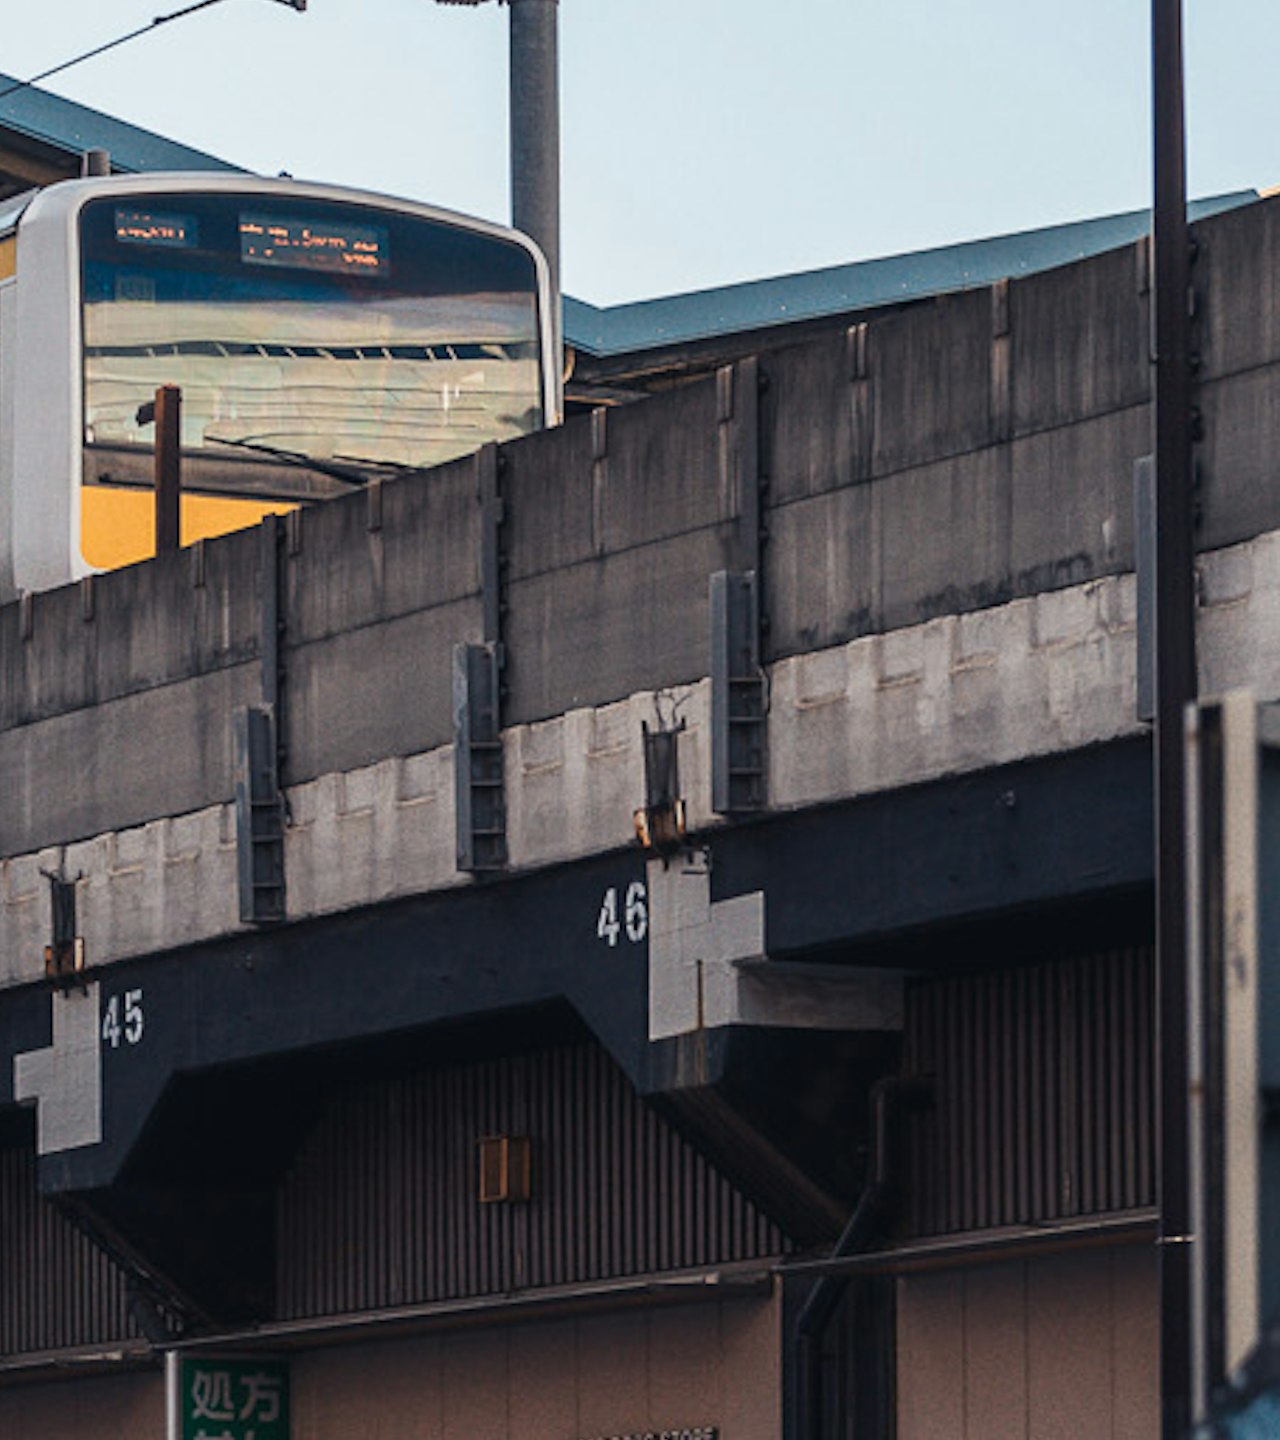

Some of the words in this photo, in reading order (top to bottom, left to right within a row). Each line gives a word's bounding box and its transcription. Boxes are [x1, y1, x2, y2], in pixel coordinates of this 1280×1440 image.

[597, 880, 647, 947] 46
[101, 987, 143, 1049] 45
[192, 1369, 282, 1423] 処方
